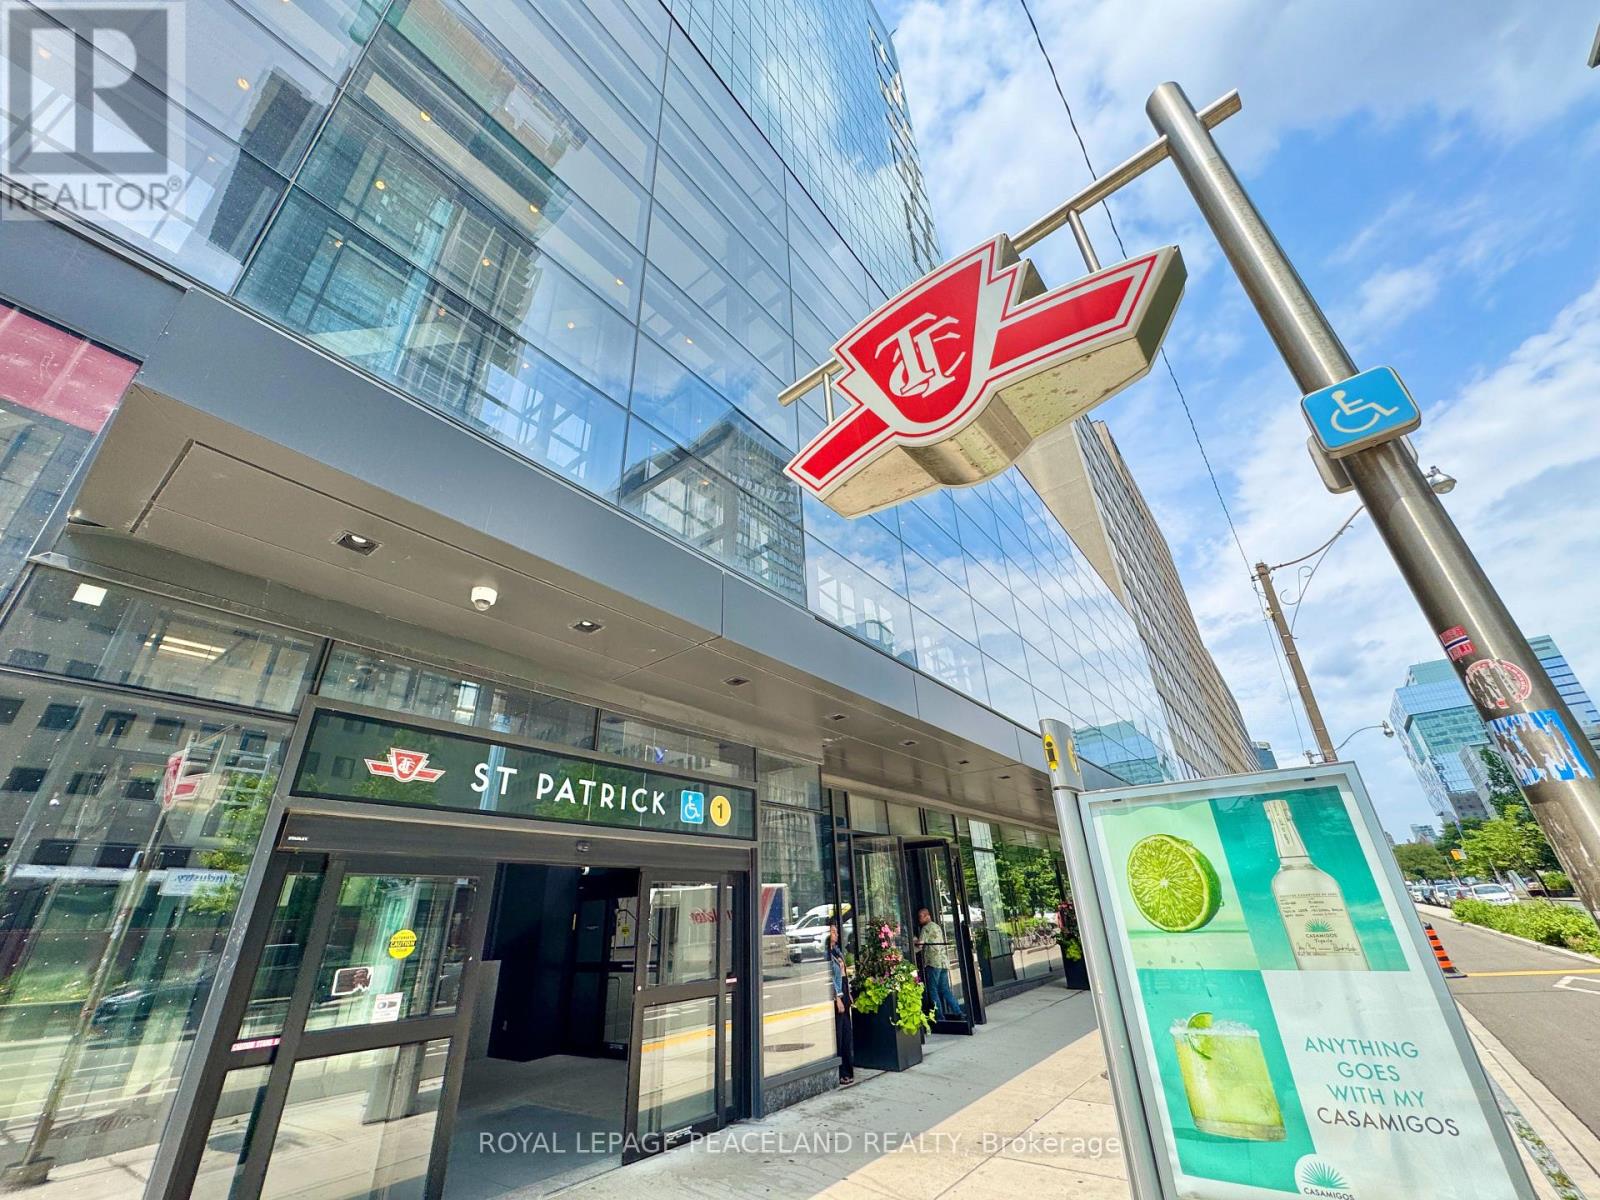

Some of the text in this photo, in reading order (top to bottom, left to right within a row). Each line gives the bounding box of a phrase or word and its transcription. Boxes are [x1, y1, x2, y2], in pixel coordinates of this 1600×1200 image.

[470, 763, 666, 816] ST PATRICK
[1304, 1037, 1419, 1059] ANYTHING
[1336, 1061, 1401, 1082] GOES
[1326, 1083, 1425, 1108] WITH MY
[1316, 1107, 1460, 1137] CASAMIGOS
[1303, 1187, 1355, 1200] CASAMIGOS
